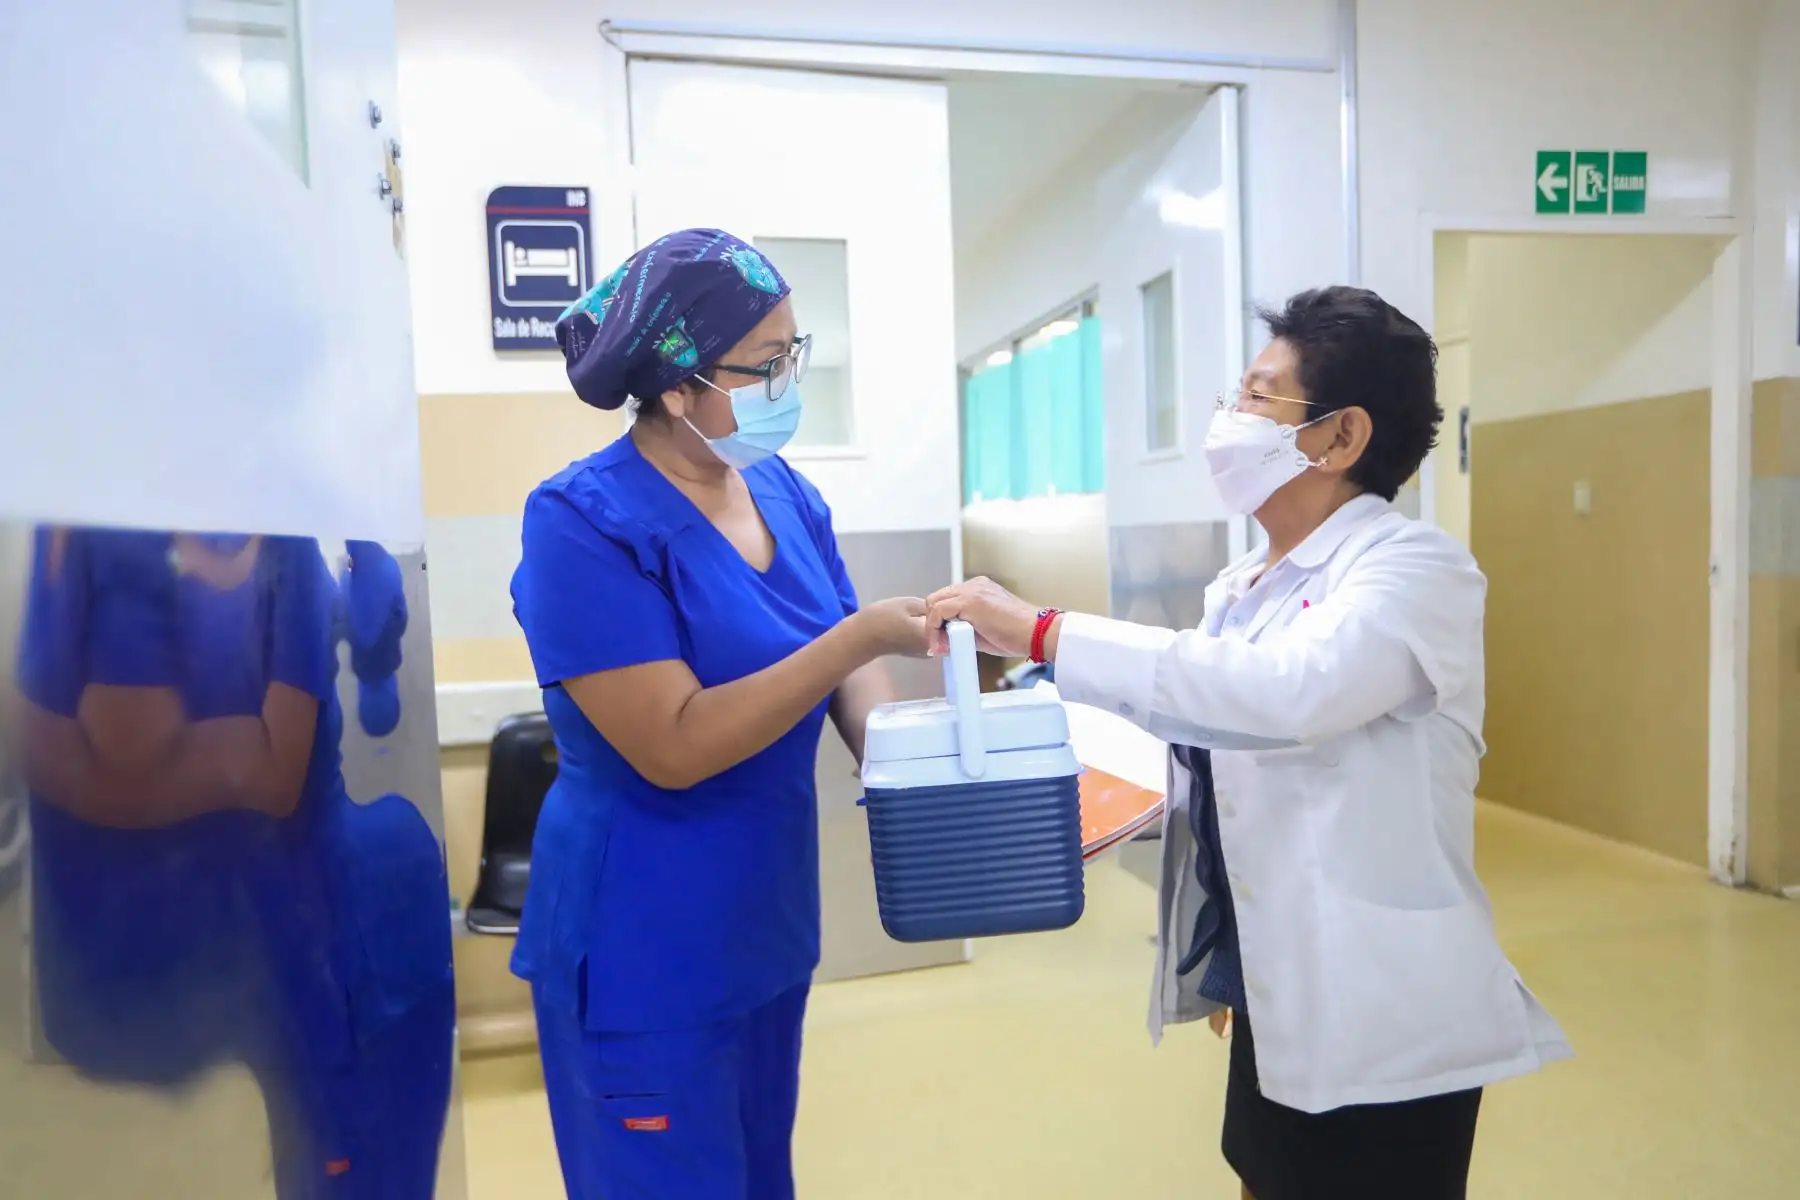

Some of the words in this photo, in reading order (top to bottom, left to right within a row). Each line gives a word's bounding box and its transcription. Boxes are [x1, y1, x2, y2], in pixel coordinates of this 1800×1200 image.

[1613, 175, 1645, 191] SALIDA
[494, 317, 516, 337] Sala
[518, 317, 530, 337] de
[530, 316, 557, 337] Recu
